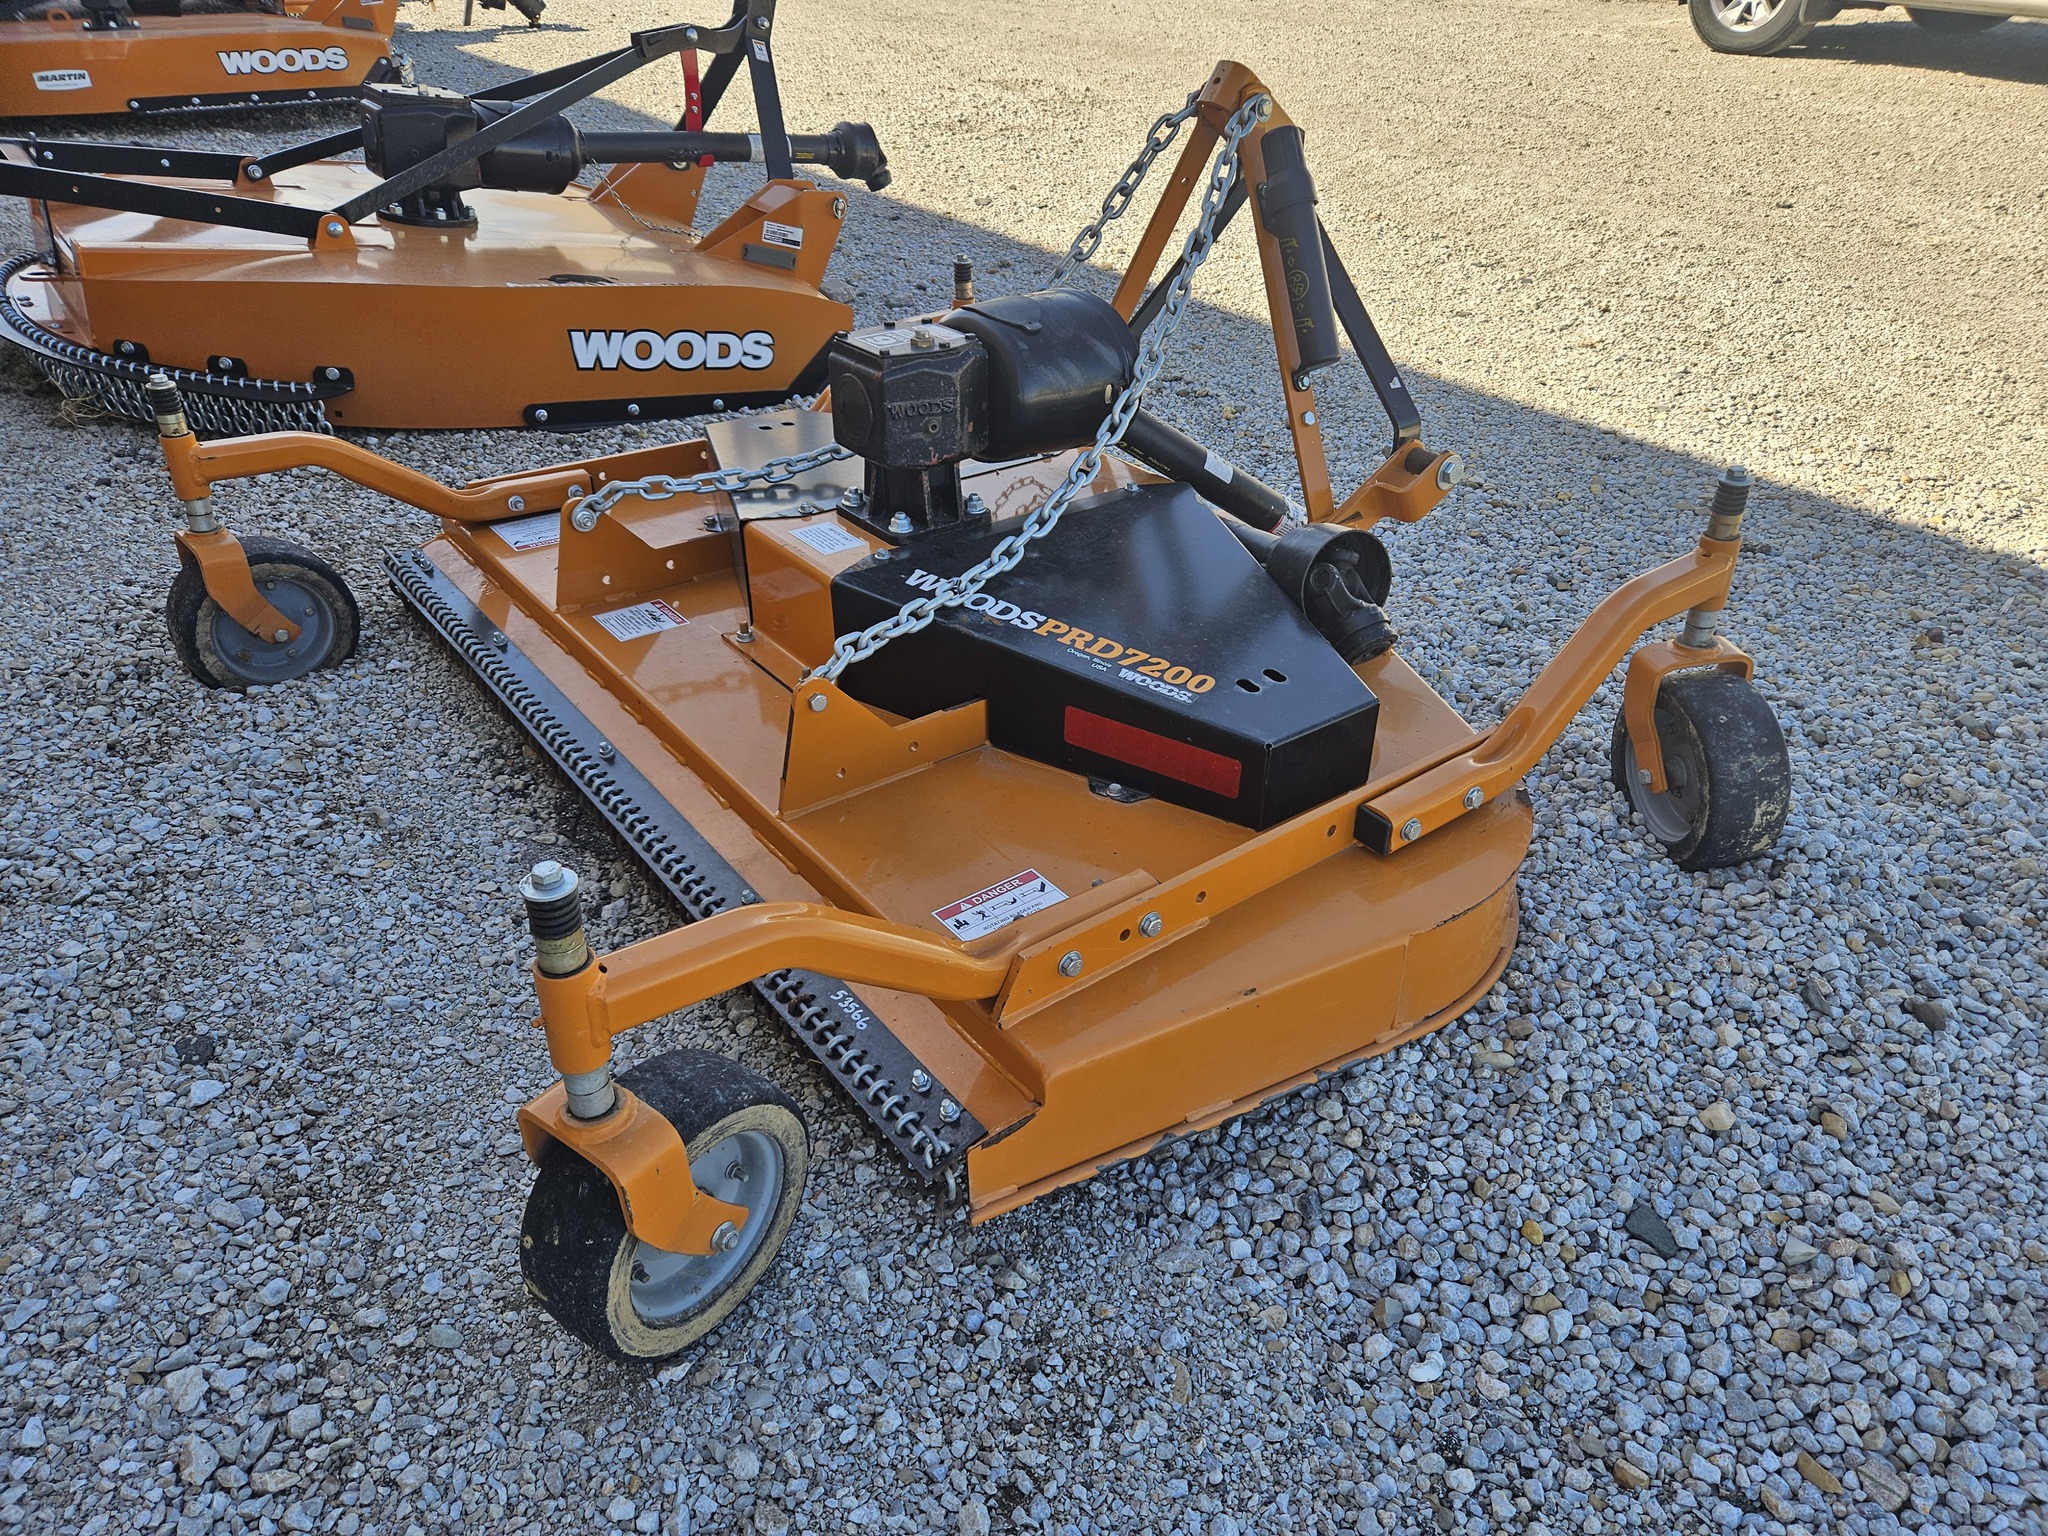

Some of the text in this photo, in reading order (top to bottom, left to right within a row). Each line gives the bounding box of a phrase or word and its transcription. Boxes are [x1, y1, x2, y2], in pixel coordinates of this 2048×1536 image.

[217, 47, 348, 75] WOODS
[37, 72, 87, 82] MARTIN
[567, 328, 775, 371] WOODS
[887, 400, 955, 419] WOODS
[905, 569, 1047, 629] WODS
[1091, 663, 1107, 672] USA
[972, 879, 1023, 905] DANGER
[983, 916, 1010, 931] ROTATING
[1031, 901, 1043, 909] AND
